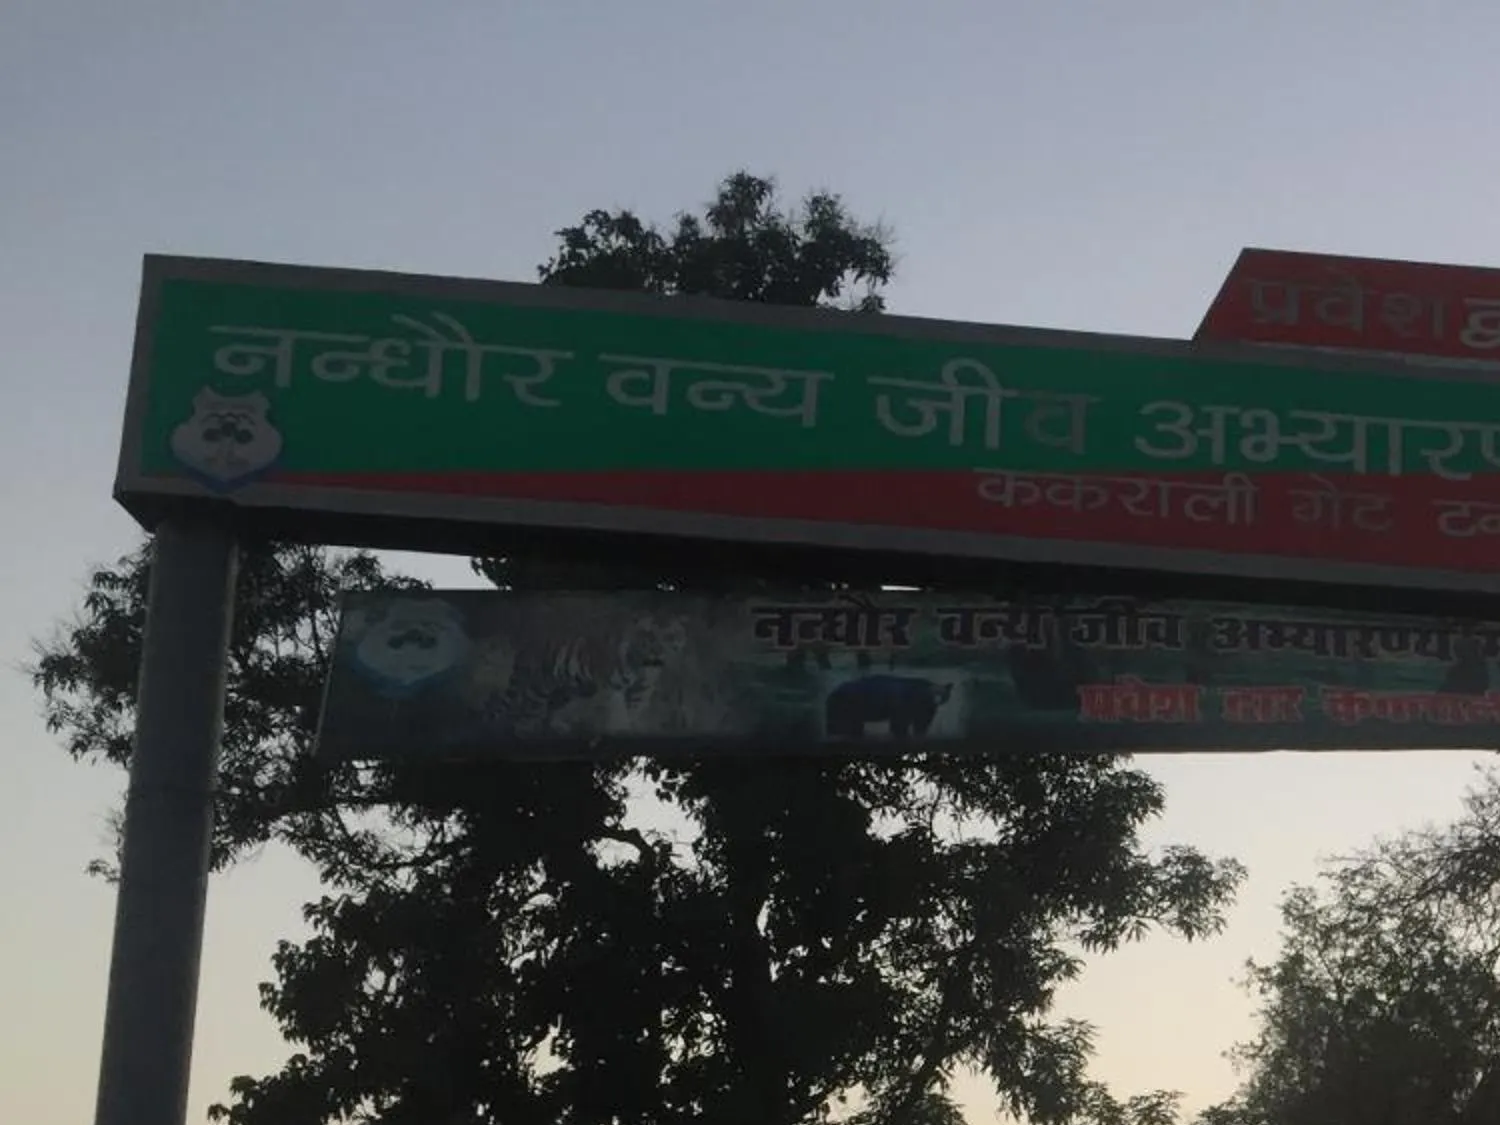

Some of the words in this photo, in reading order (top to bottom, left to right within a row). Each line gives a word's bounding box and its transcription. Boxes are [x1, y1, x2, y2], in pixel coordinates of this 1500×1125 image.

[1246, 273, 1445, 339] प्रवेश
[208, 312, 574, 406] नन्धौर
[597, 353, 834, 428] वन्य
[867, 357, 1099, 454] जीव
[973, 466, 1260, 526] ककराली
[1288, 473, 1396, 533] गेट
